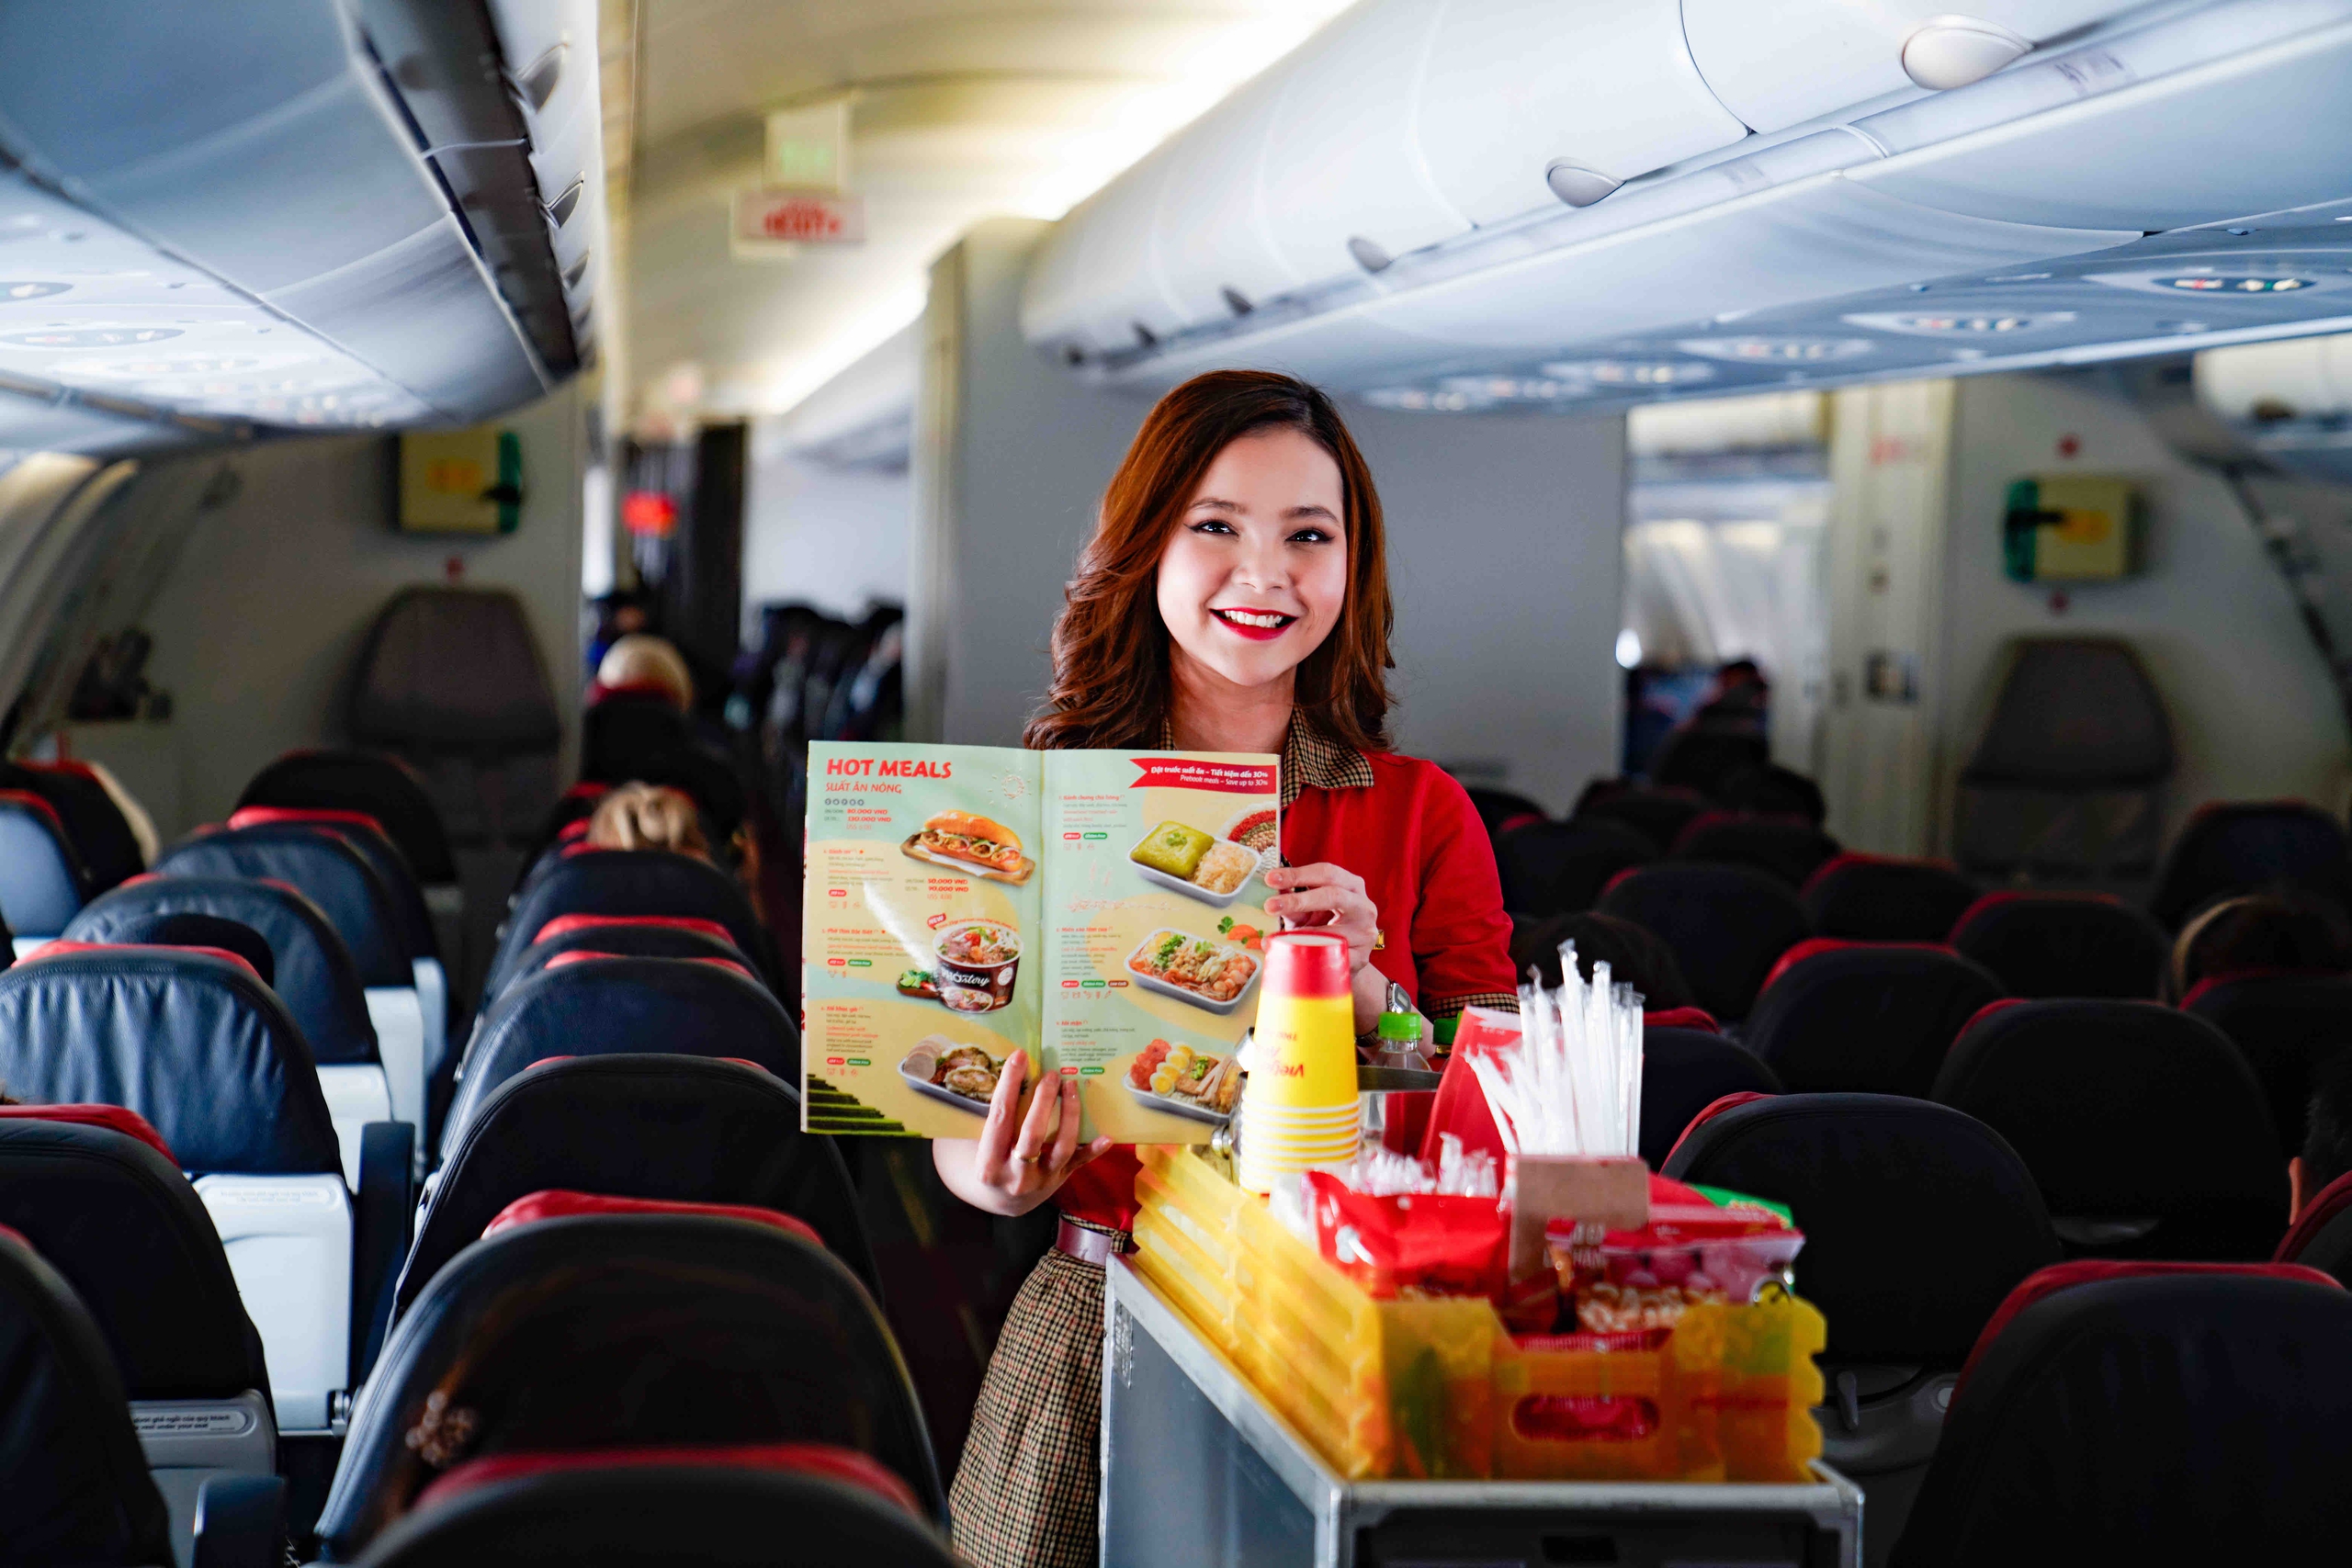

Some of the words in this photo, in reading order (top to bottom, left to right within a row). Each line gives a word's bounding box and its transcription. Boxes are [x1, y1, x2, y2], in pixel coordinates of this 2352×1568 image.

[827, 759, 874, 776] HOT
[878, 760, 952, 779] MEALS
[1180, 774, 1203, 783] Prebook
[1204, 775, 1219, 784] meals
[826, 779, 850, 792] SUẤT
[853, 781, 868, 792] ĂN
[928, 915, 944, 924] NEW
